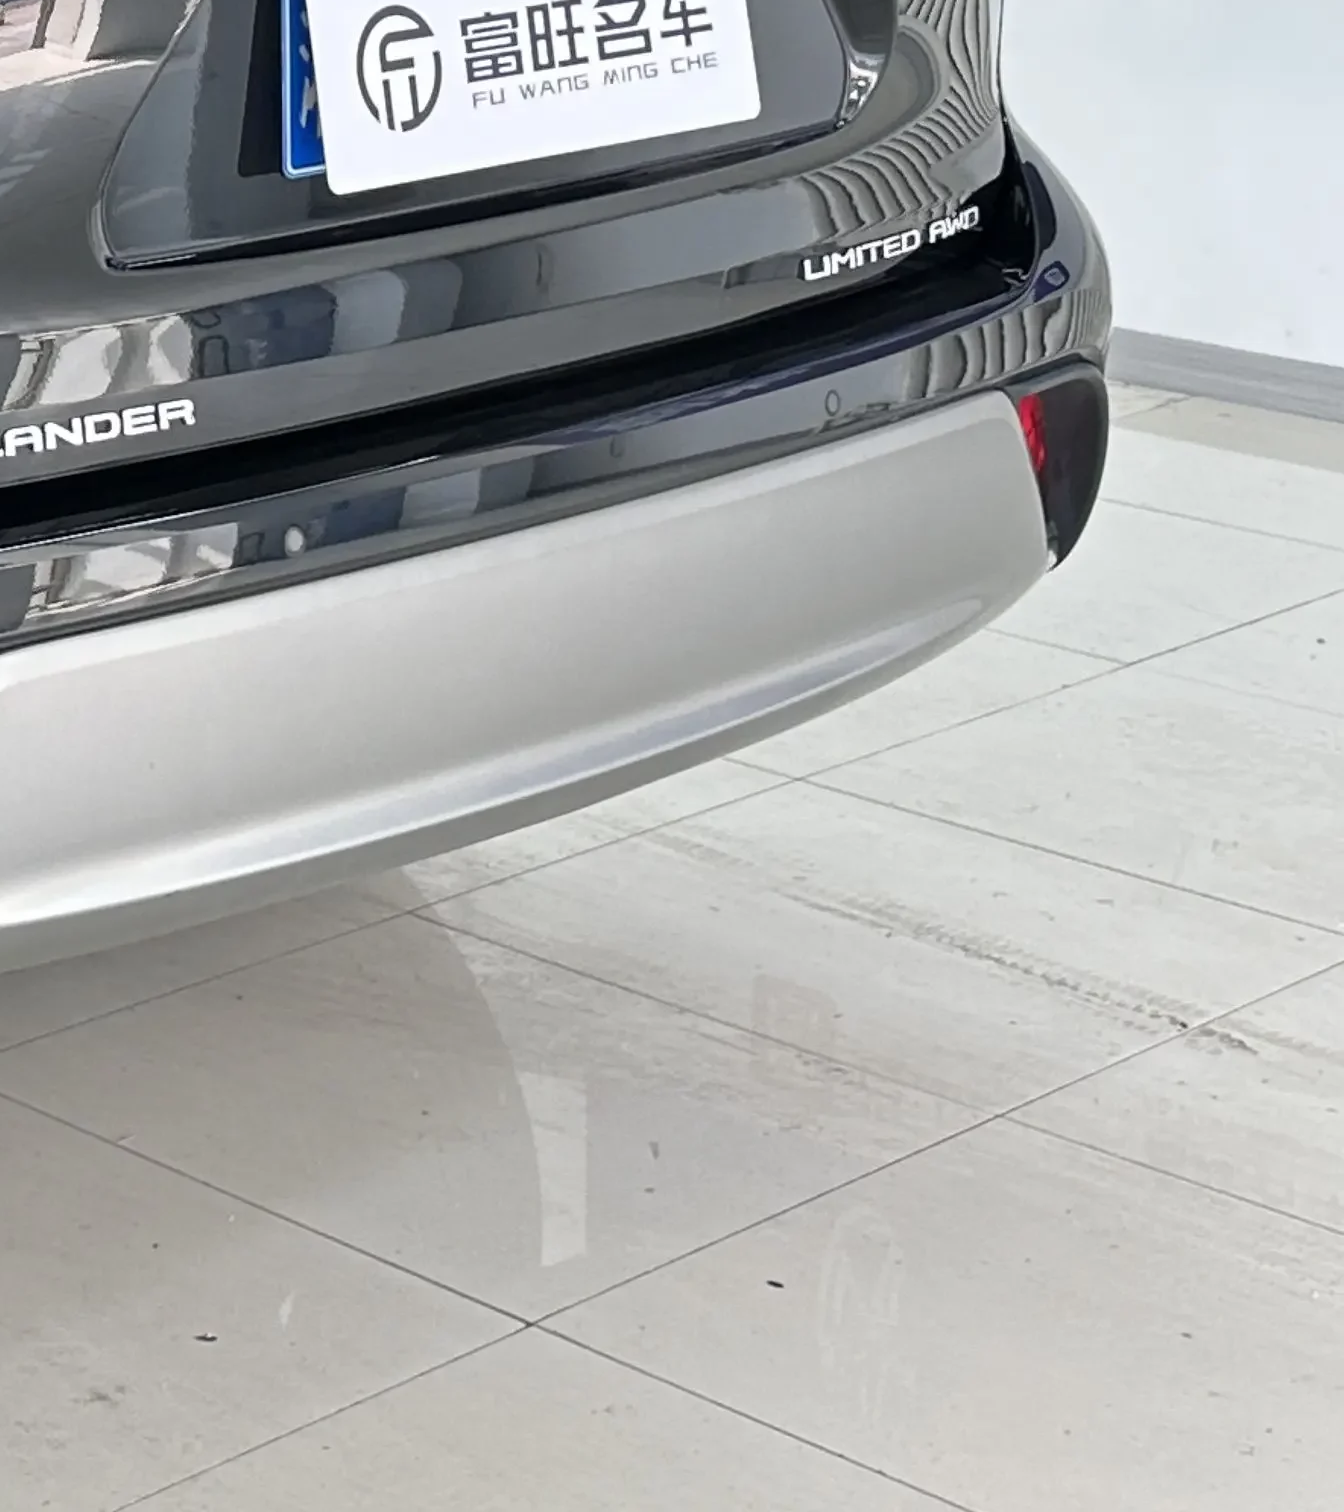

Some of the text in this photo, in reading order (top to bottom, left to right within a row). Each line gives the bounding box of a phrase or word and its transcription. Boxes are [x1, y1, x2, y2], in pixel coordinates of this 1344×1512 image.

[472, 51, 719, 108] FU WANG MING CHE
[803, 205, 980, 281] LIMITED AWD
